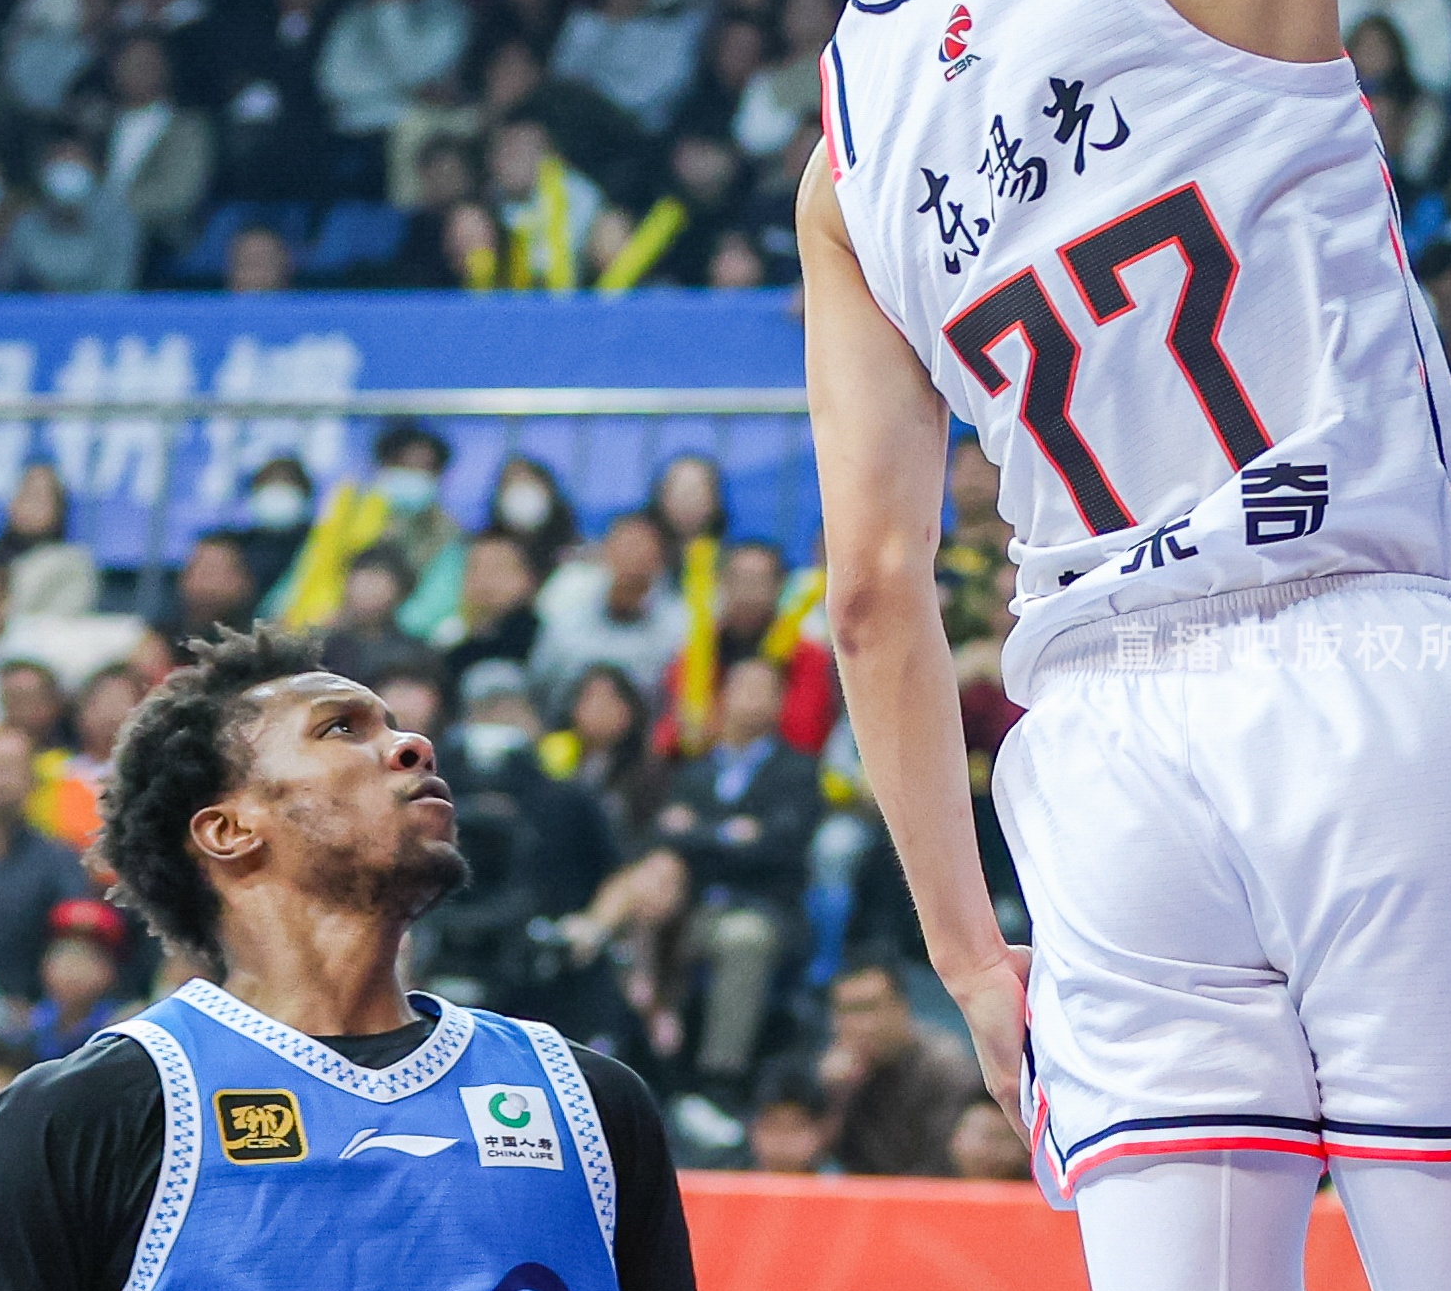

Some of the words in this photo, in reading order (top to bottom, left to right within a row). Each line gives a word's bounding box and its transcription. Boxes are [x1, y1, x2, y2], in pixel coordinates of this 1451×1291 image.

[944, 54, 981, 82] CBA
[943, 181, 1274, 537] 77
[488, 1150, 526, 1158] CHINA
[529, 1152, 554, 1160] LIFE
